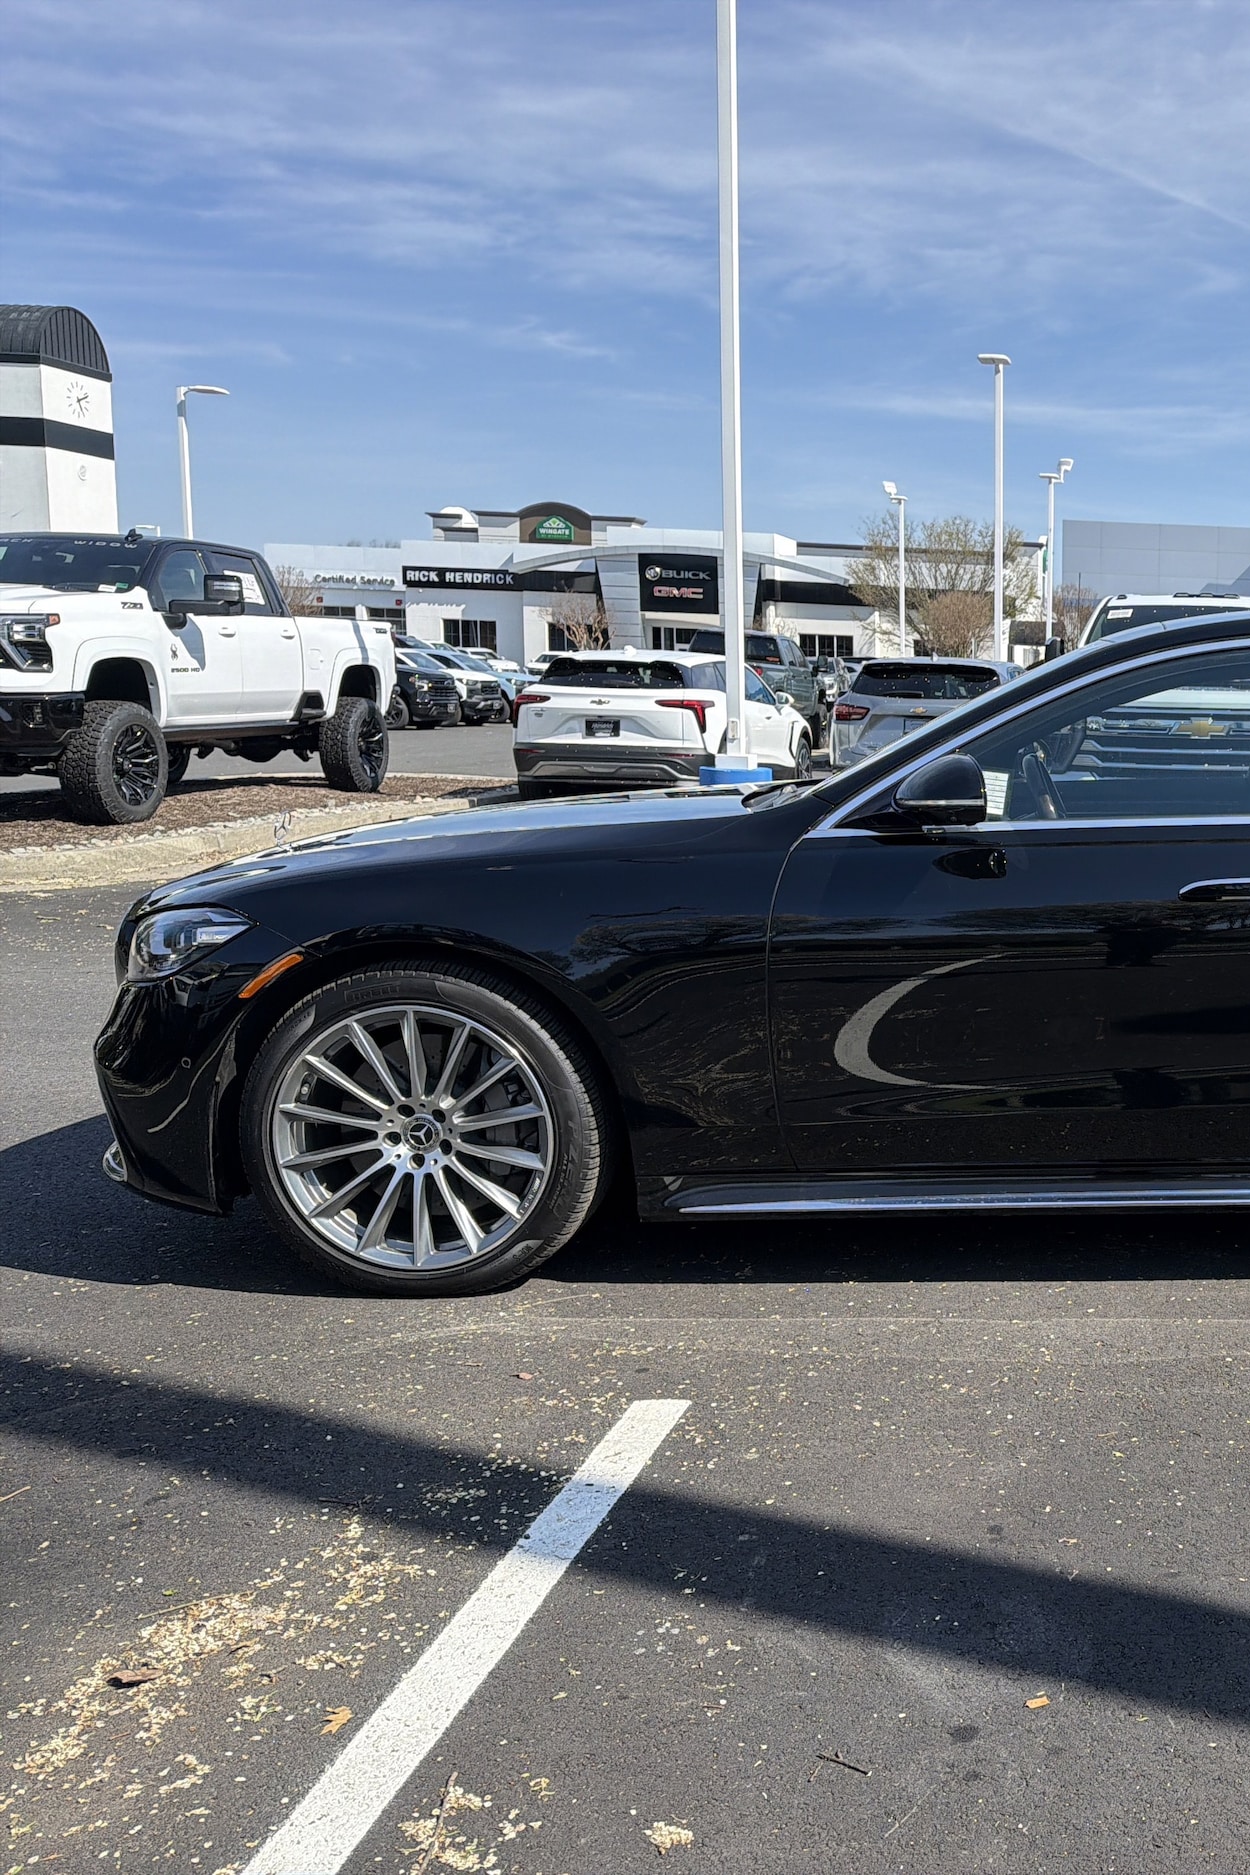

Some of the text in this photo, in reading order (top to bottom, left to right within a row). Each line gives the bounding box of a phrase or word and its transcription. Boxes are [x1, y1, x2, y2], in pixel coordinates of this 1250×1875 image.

[539, 527, 570, 536] WINGATE
[73, 540, 138, 549] WIDOW
[314, 574, 396, 587] Certified Service
[406, 569, 514, 585] RICK HENDRICK
[661, 569, 712, 581] BUICK
[653, 585, 704, 600] GMC
